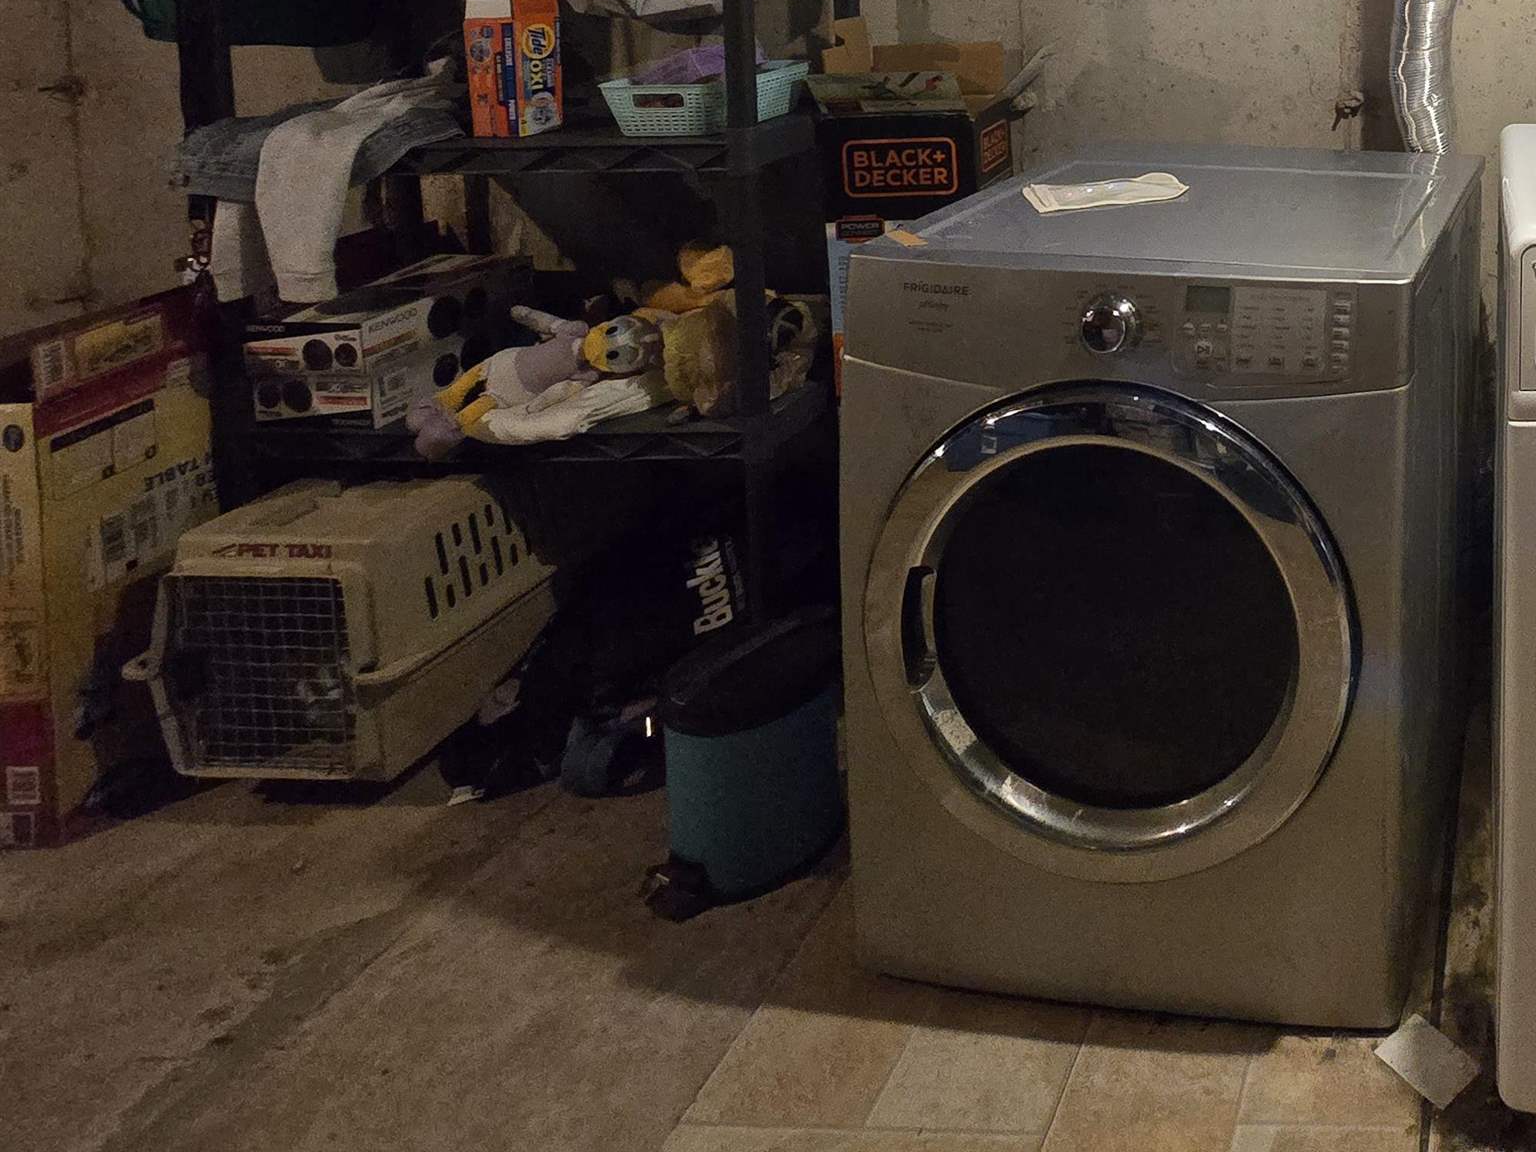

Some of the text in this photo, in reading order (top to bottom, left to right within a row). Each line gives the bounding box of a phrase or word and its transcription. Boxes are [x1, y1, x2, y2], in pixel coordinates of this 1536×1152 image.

[528, 26, 546, 56] Tide
[530, 60, 545, 90] OXI
[853, 148, 947, 167] BLACK+
[853, 167, 949, 187] DECKER
[904, 281, 970, 296] FRIGIDAIRE
[247, 324, 286, 333] KENWOOD
[368, 306, 418, 334] KENWOOD
[144, 457, 200, 493] TABLE
[238, 543, 333, 558] PET TAXI
